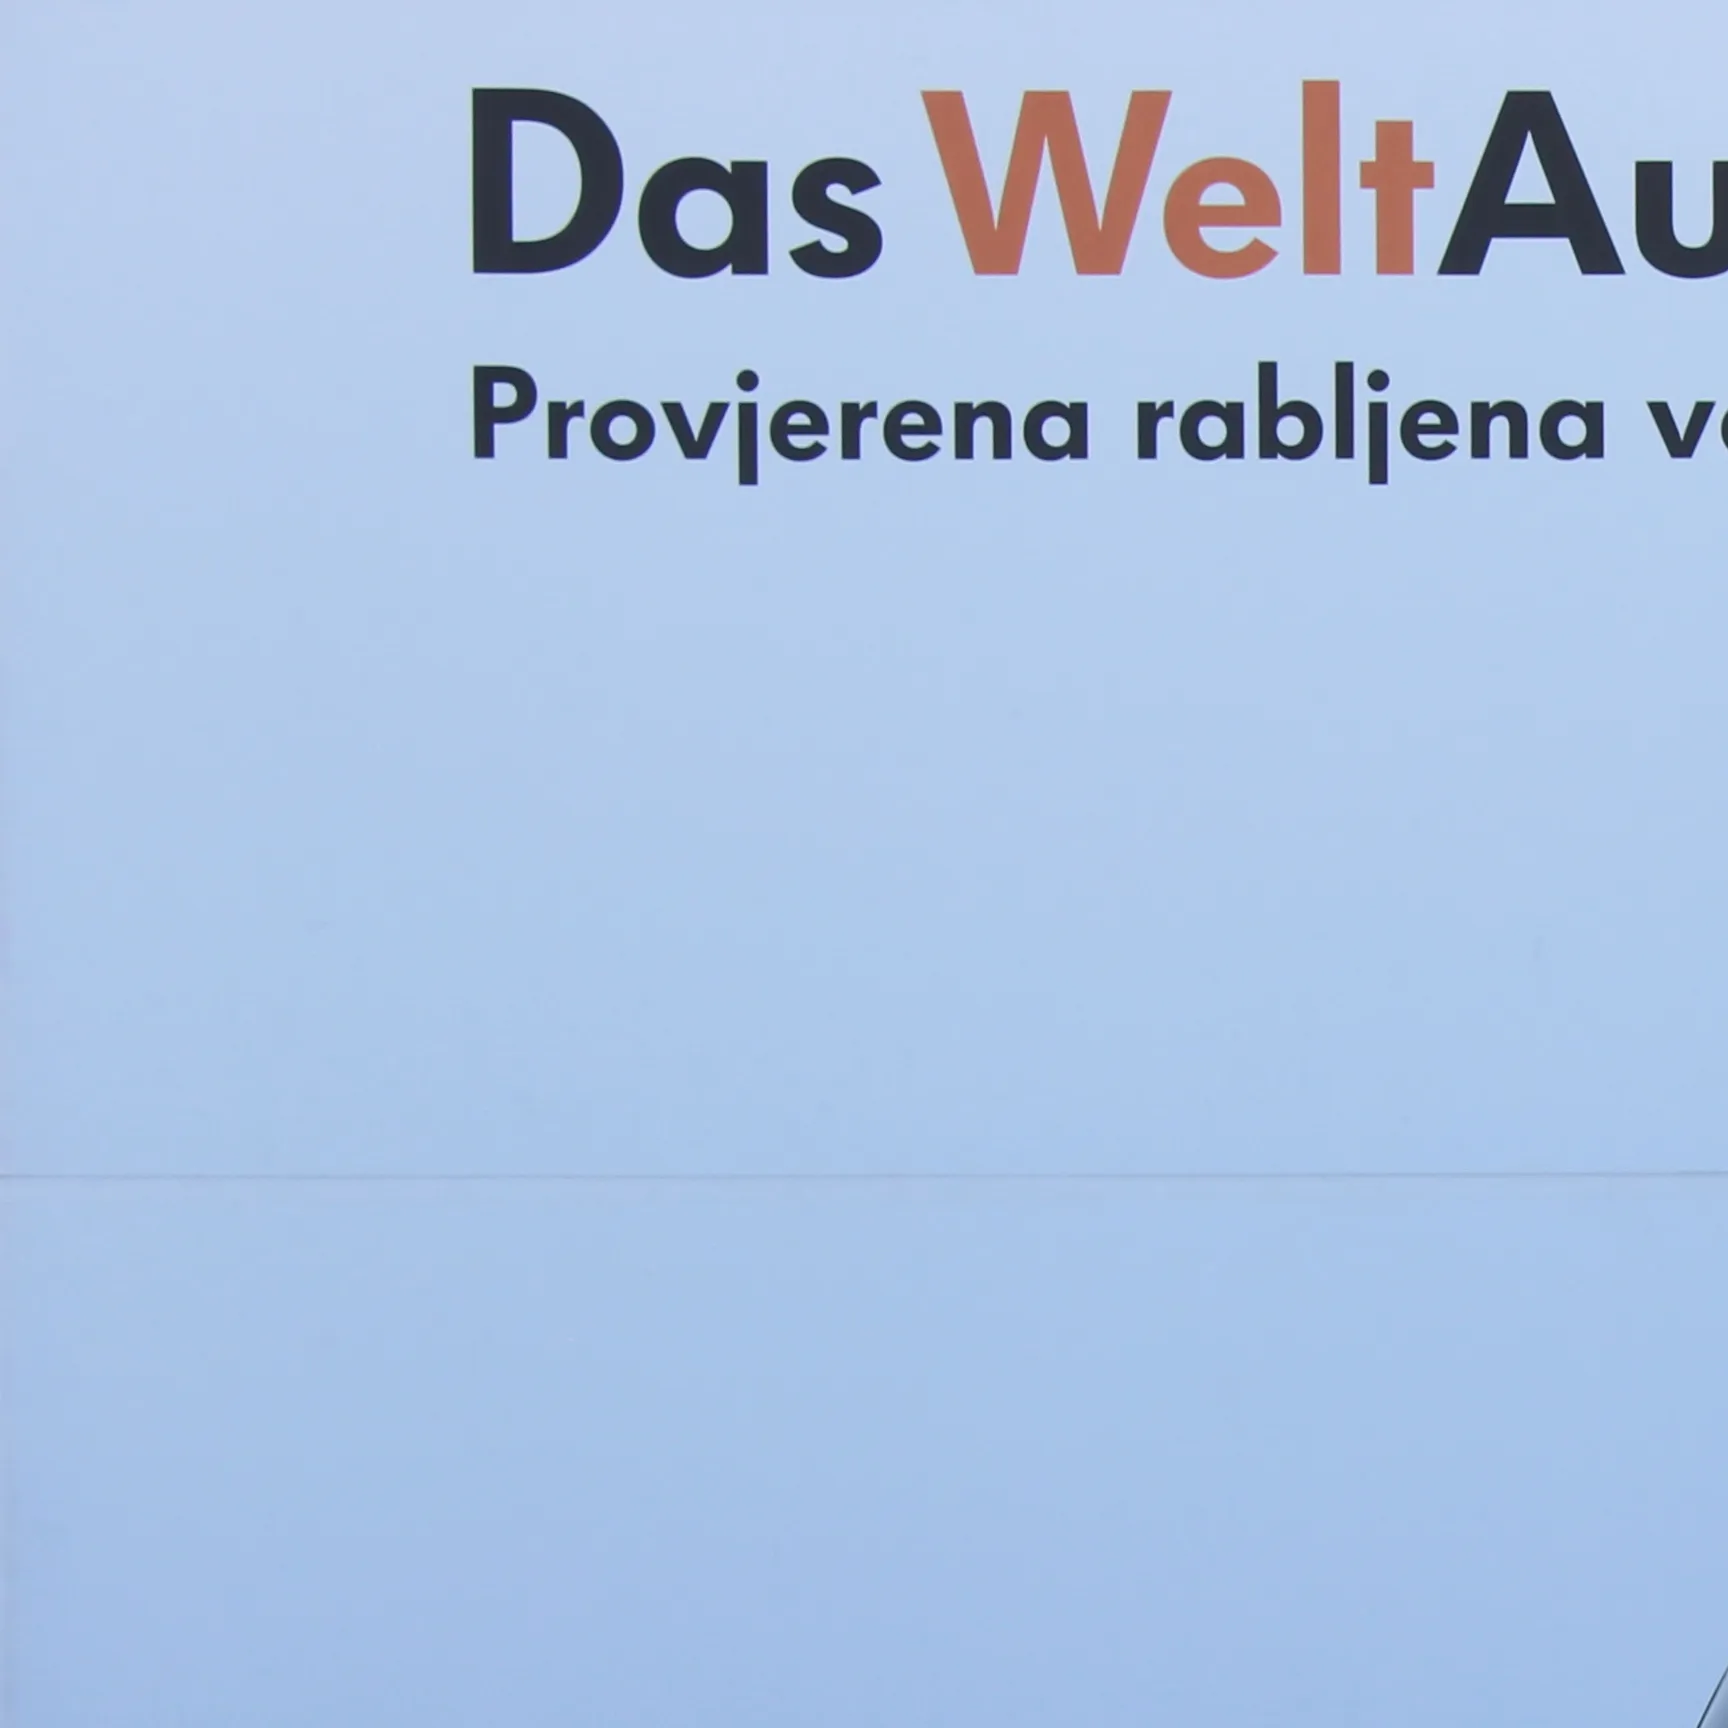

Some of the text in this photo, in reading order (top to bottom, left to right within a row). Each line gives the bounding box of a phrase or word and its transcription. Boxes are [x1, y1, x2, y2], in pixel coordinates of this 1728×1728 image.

[470, 86, 884, 280] Das
[470, 363, 1089, 487] Provjerena
[1135, 359, 1606, 487] rabljena
